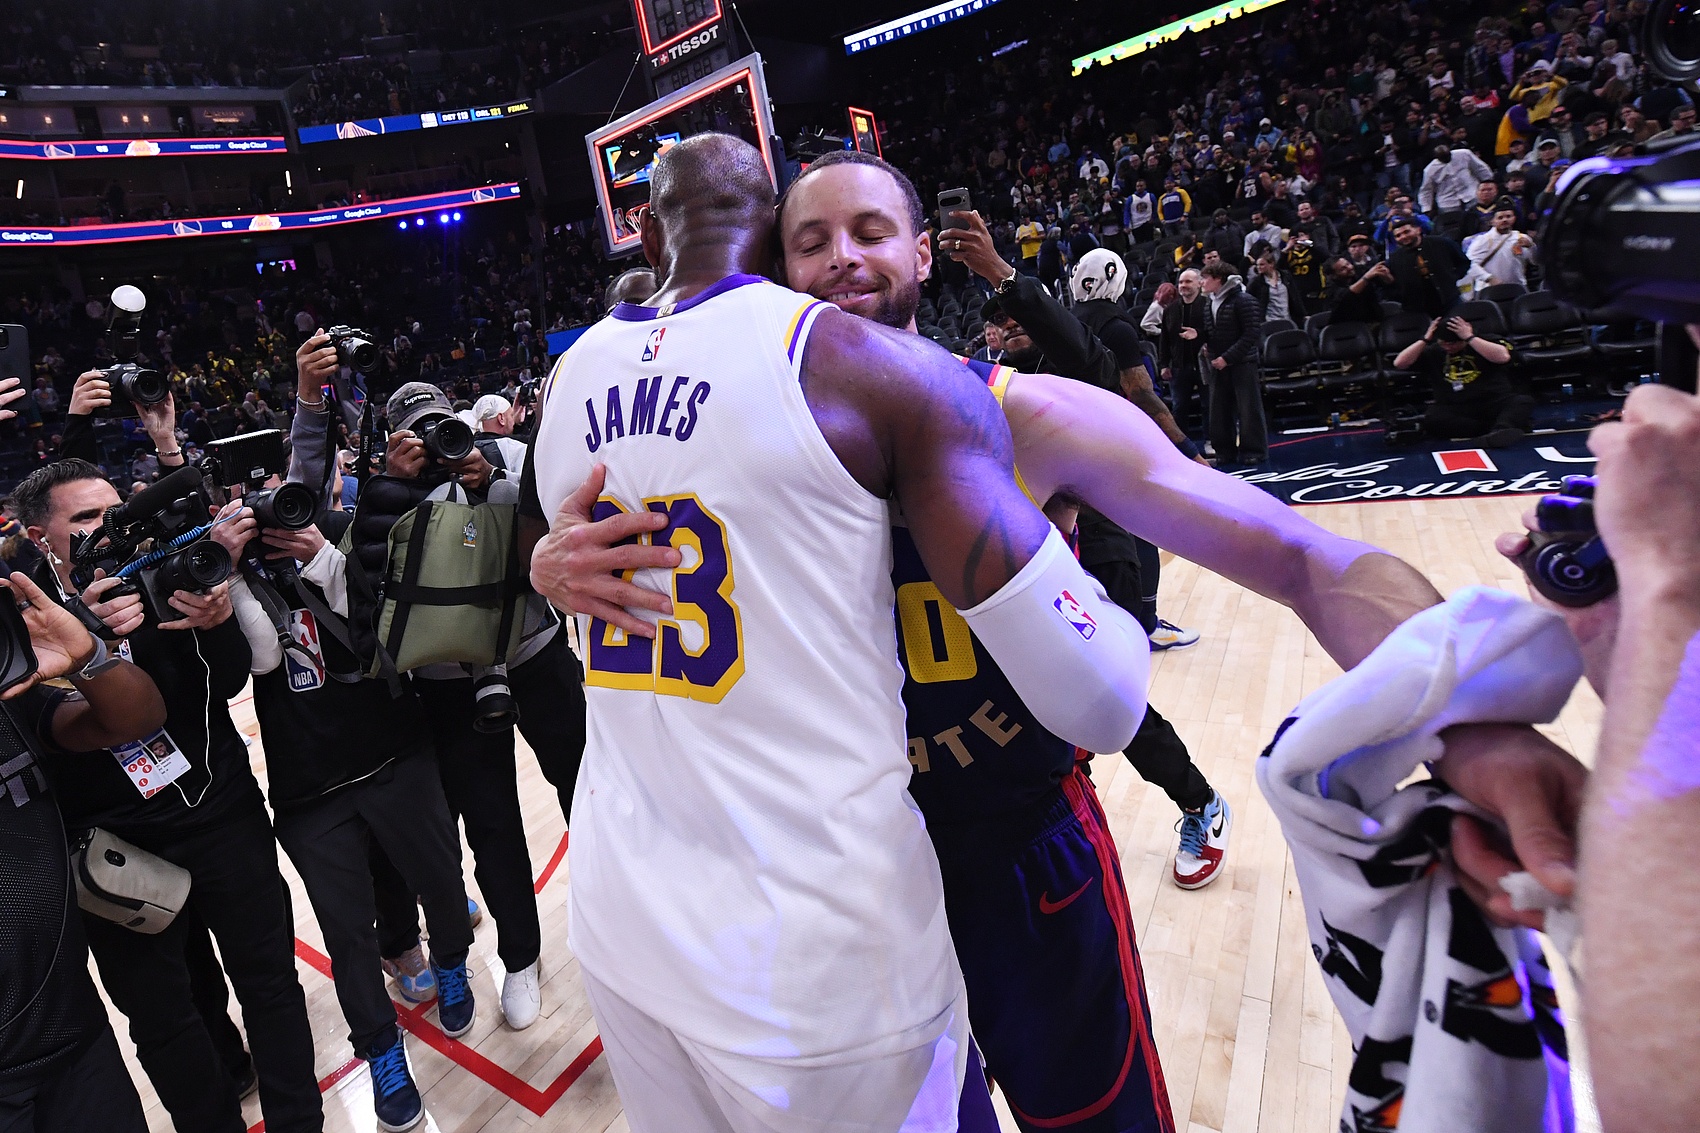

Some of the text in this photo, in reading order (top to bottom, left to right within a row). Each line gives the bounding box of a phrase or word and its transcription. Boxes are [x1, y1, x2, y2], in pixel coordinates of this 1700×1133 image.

[668, 25, 719, 60] TISSOT
[507, 103, 529, 113] FINAL
[228, 141, 250, 150] Google
[249, 141, 268, 149] Cloud
[344, 209, 365, 218] Google
[365, 207, 381, 216] Cloud
[2, 232, 54, 241] Google Cloud
[404, 394, 432, 406] Supreme
[585, 375, 711, 453] JAMES
[294, 671, 314, 687] NBA
